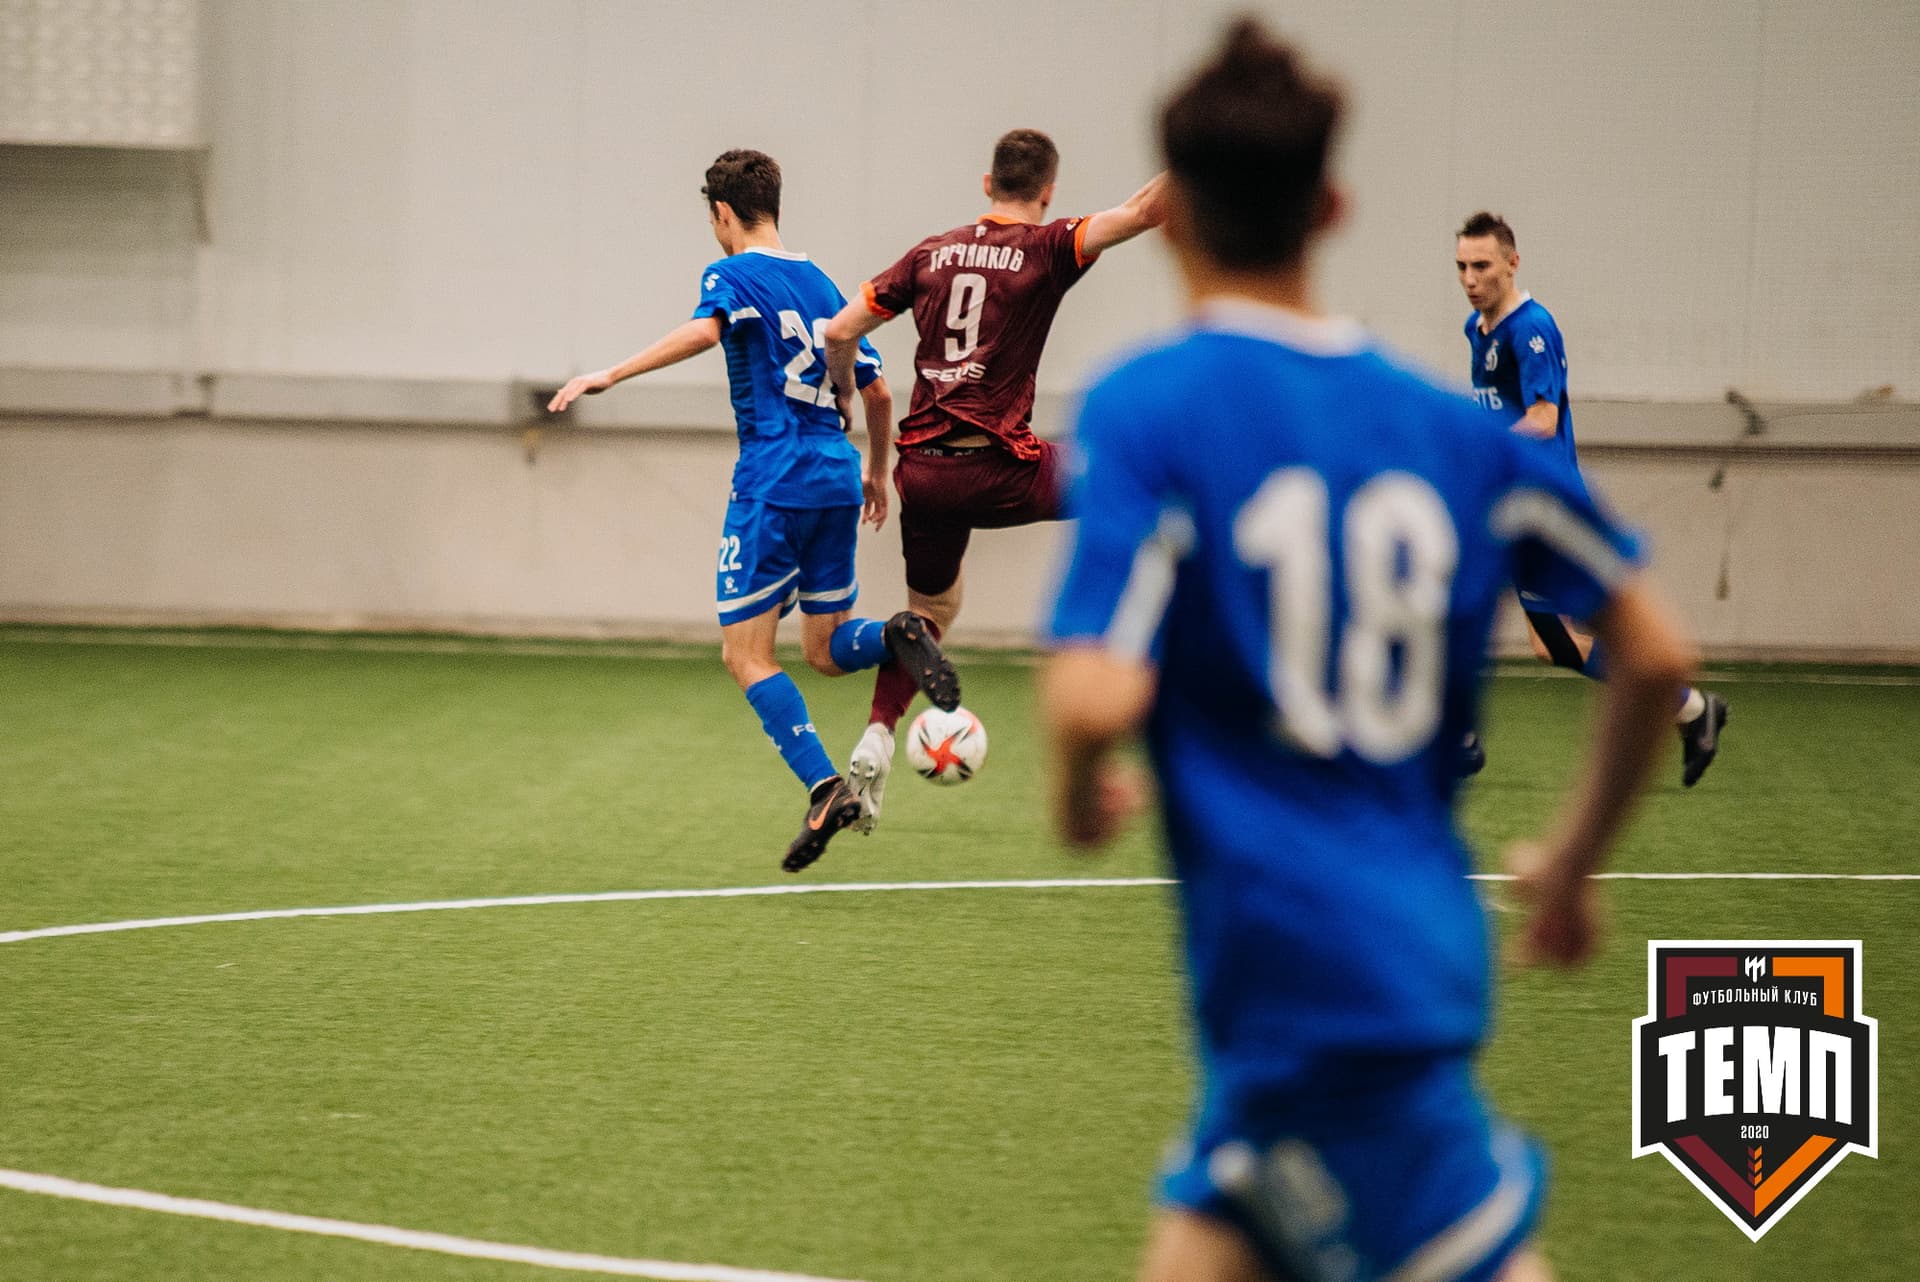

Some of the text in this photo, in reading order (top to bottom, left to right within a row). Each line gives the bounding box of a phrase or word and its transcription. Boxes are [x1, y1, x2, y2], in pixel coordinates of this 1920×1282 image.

[944, 273, 987, 362] 9
[719, 534, 743, 573] 22
[1232, 464, 1460, 766] 18
